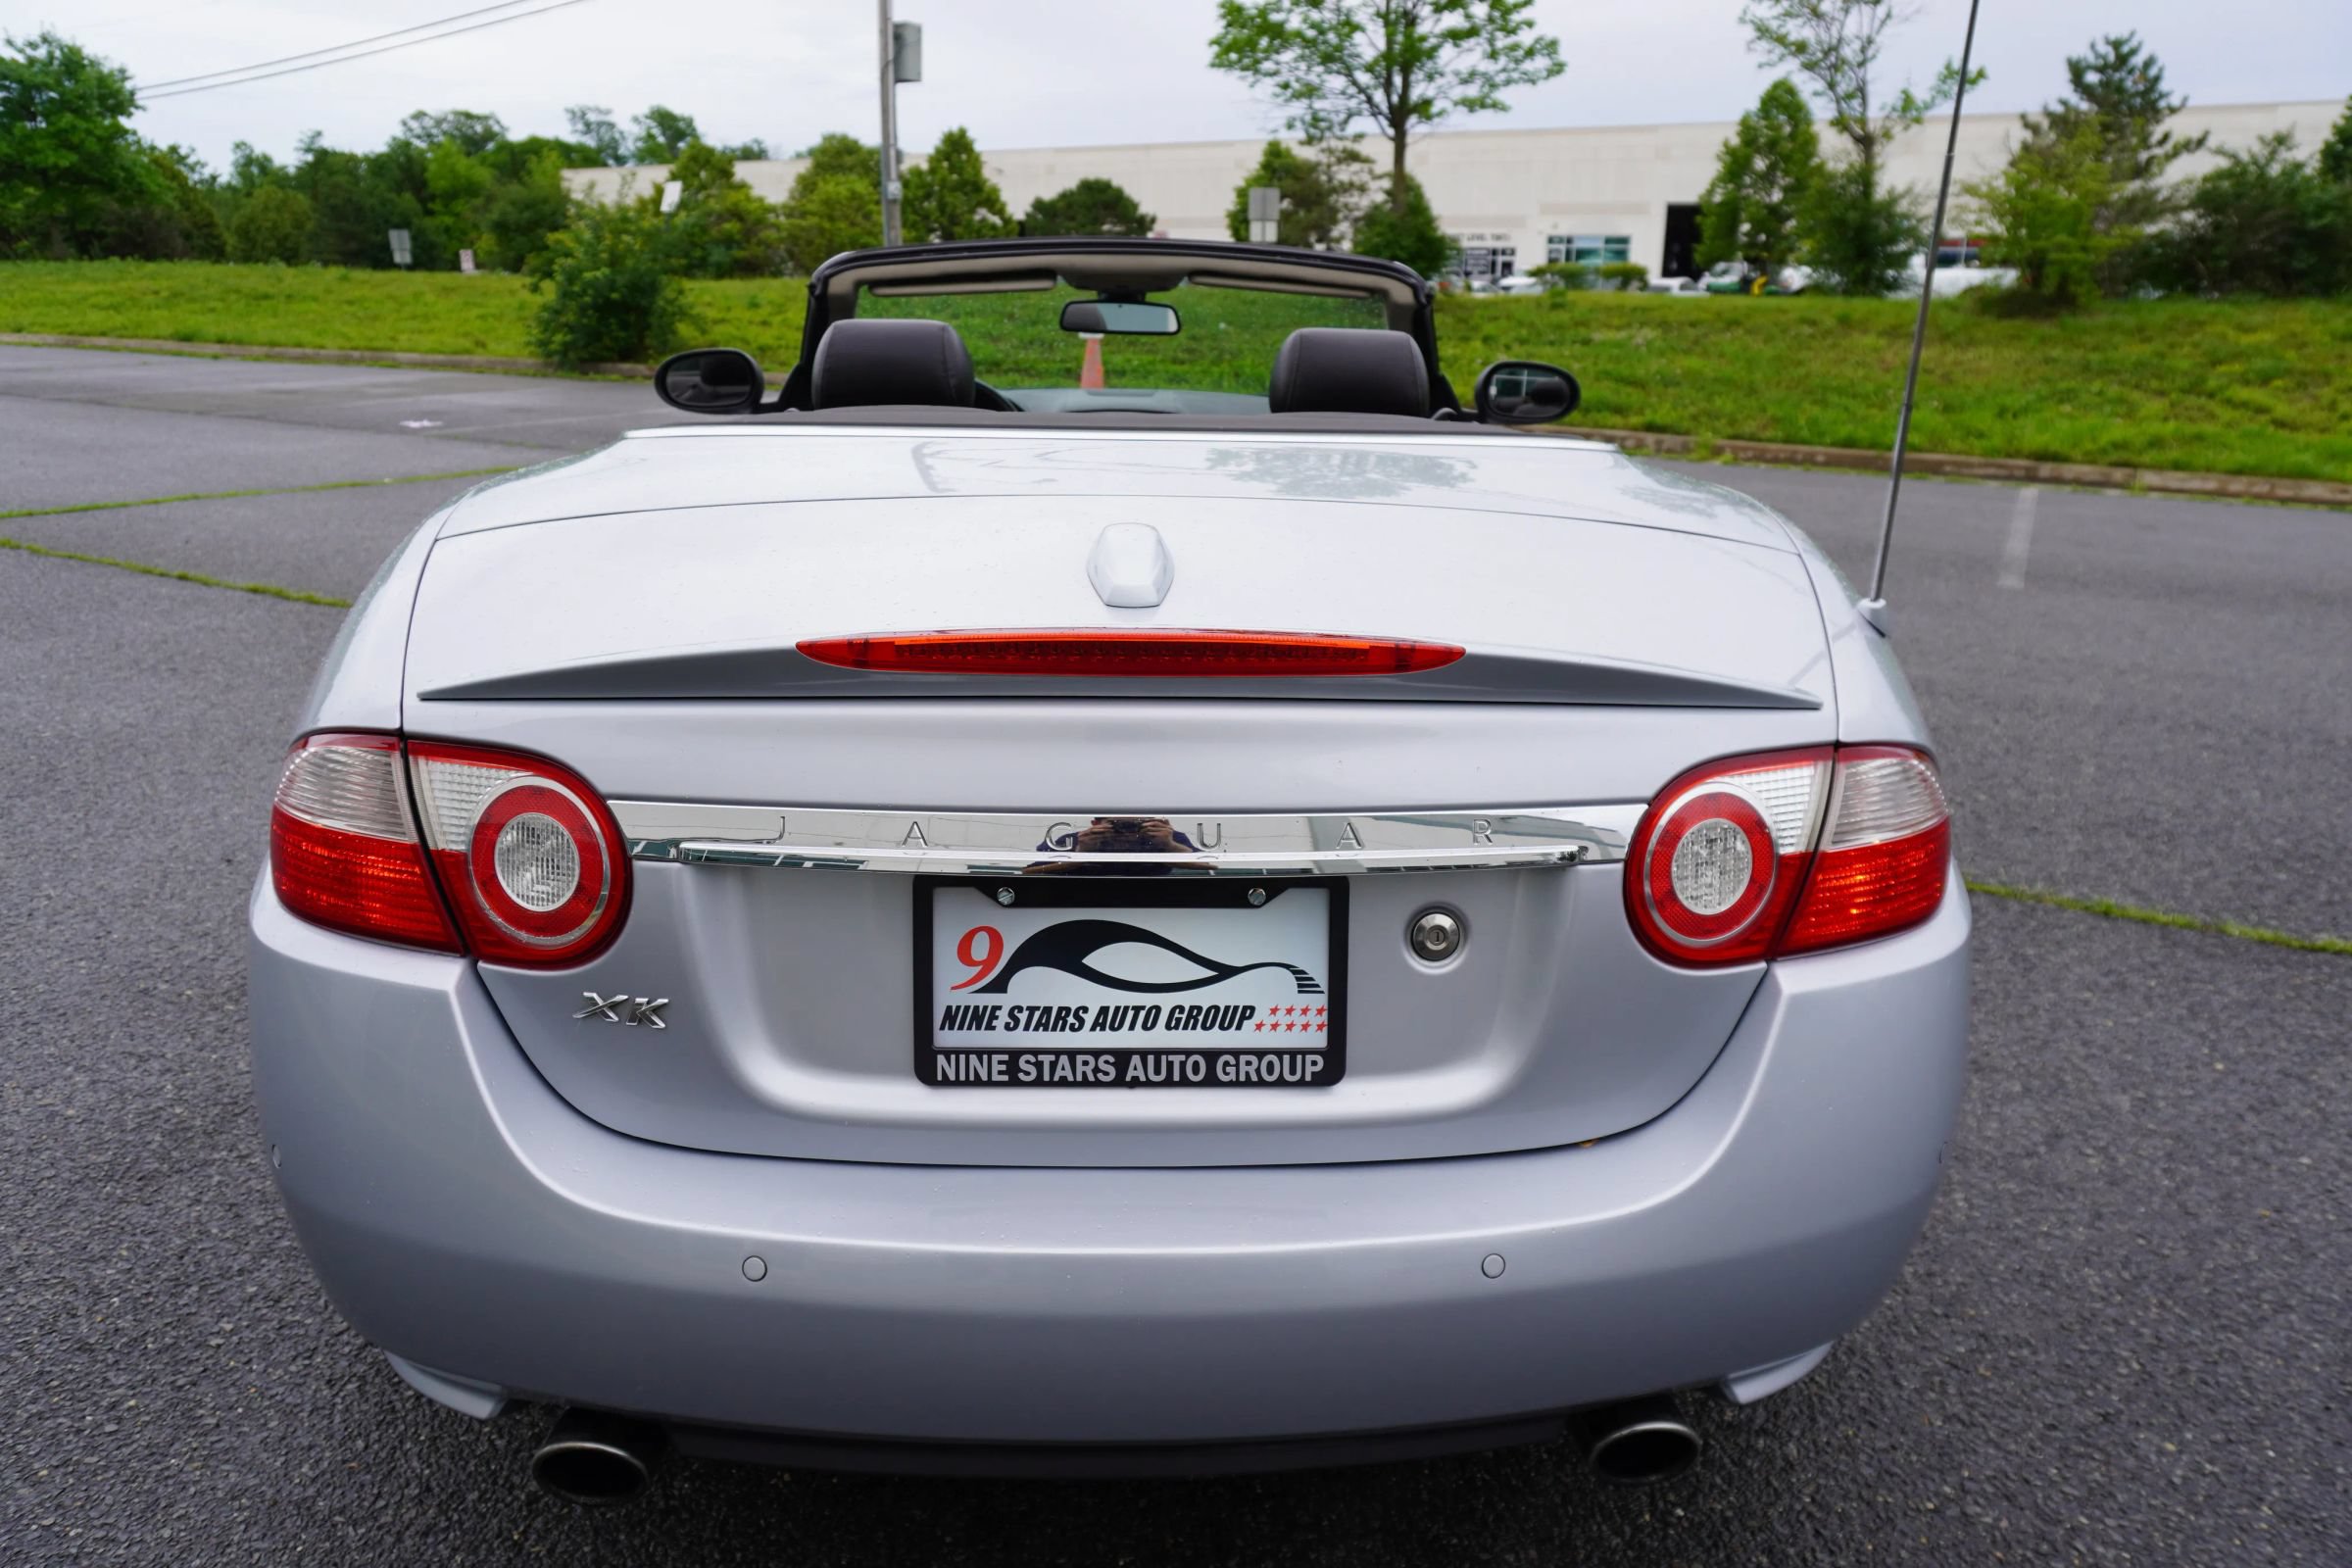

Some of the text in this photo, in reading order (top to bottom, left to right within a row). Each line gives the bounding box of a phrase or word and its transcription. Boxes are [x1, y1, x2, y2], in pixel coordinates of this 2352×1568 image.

[768, 815, 1494, 852] JAGUAR
[951, 925, 1004, 991] 9
[572, 992, 669, 1029] XK
[939, 1004, 1256, 1033] NINE STARS AUTO GROUP
[936, 1054, 1324, 1083] NINE STARS AUTO GROUP
